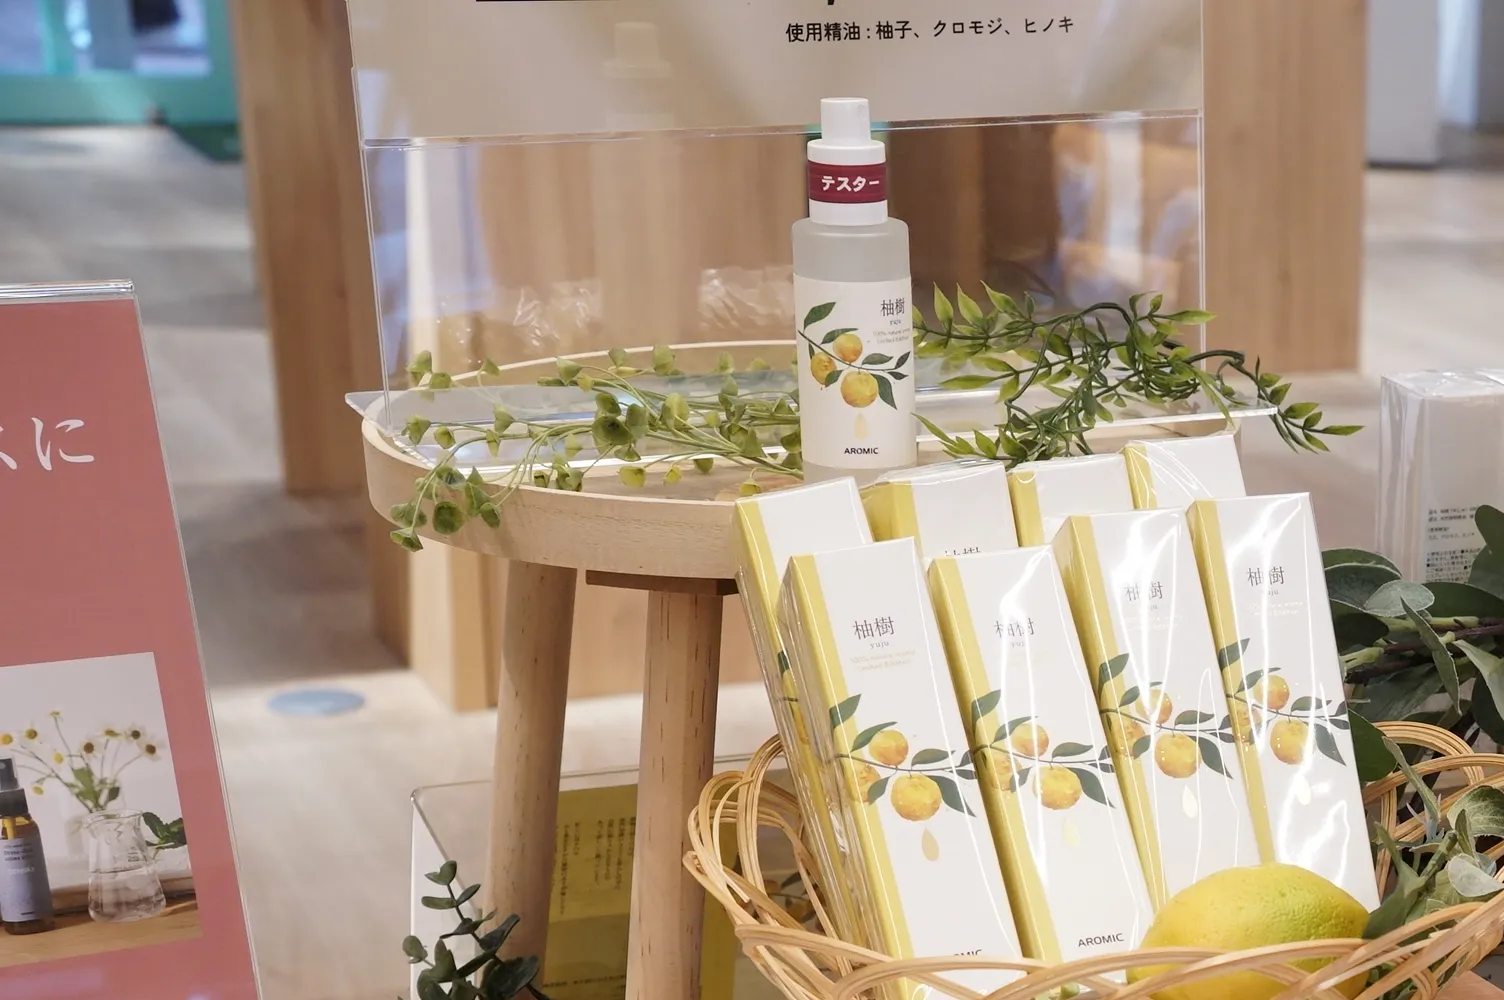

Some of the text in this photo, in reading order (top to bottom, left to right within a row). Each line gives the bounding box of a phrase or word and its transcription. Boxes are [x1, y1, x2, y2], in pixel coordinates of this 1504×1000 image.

[821, 175, 880, 193] テスター
[880, 298, 905, 316] 柚樹
[844, 447, 878, 455] AROMIC
[1246, 566, 1284, 587] 柚樹
[852, 616, 894, 640] 柚樹
[869, 641, 889, 649] yuju
[1078, 933, 1125, 948] AROMIC
